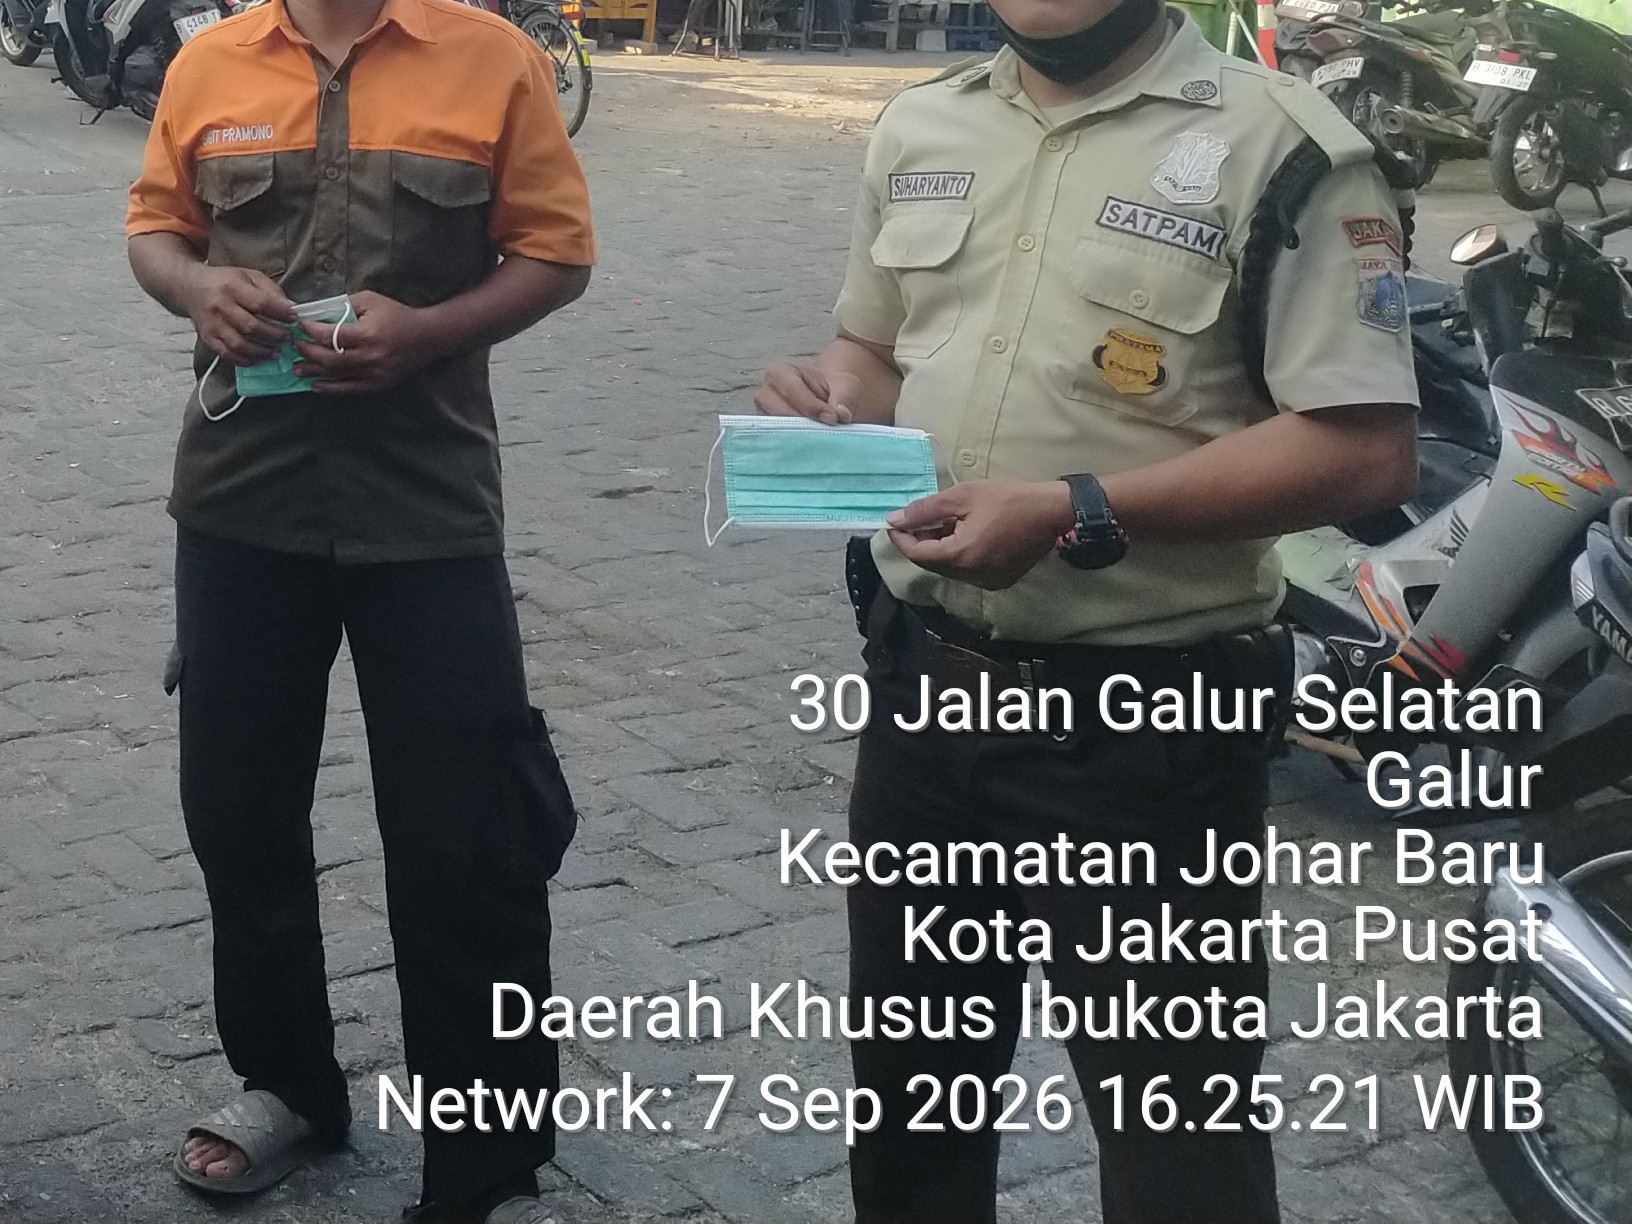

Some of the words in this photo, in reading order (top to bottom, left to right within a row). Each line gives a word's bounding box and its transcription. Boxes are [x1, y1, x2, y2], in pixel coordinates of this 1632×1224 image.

[176, 23, 183, 33] B
[186, 15, 209, 28] 4148
[1512, 68, 1532, 80] PKL
[222, 125, 274, 144] PRAMONO
[894, 176, 967, 197] SUHARYANTO
[1105, 203, 1219, 253] SATPAM
